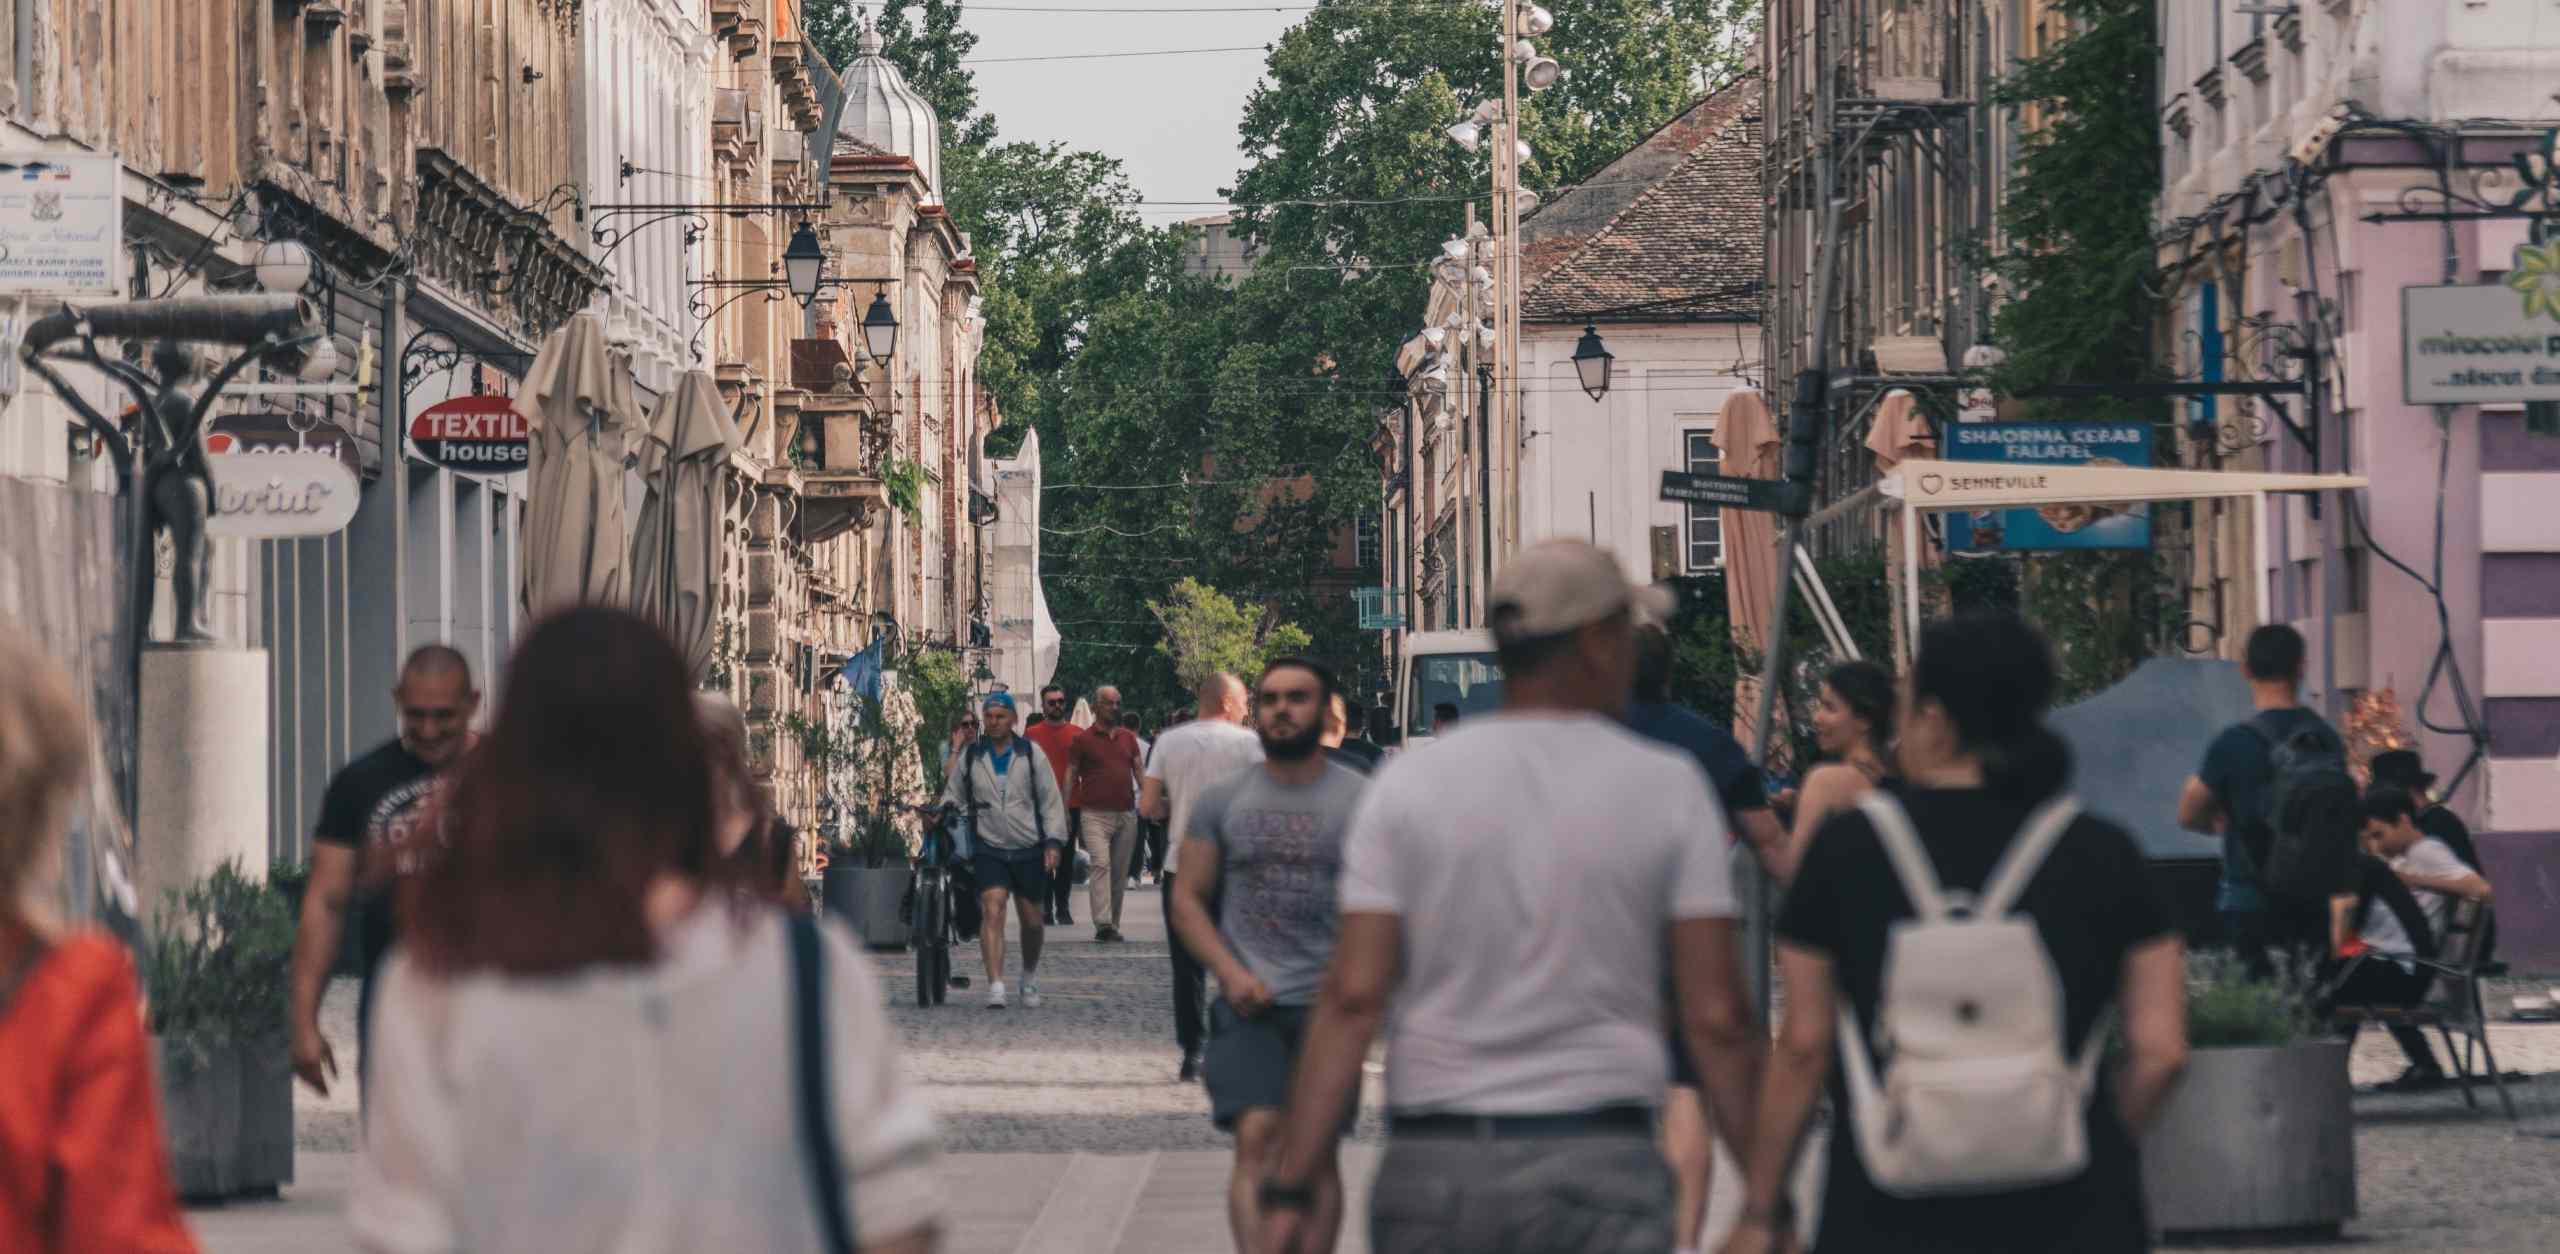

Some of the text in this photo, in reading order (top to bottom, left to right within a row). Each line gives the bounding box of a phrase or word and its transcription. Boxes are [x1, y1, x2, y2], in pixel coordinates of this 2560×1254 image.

[1958, 428, 2141, 444] SHAORMA KEBAB
[439, 440, 528, 461] house
[2005, 444, 2095, 459] FALAFEL
[1951, 476, 2049, 491] SENNEVILLE
